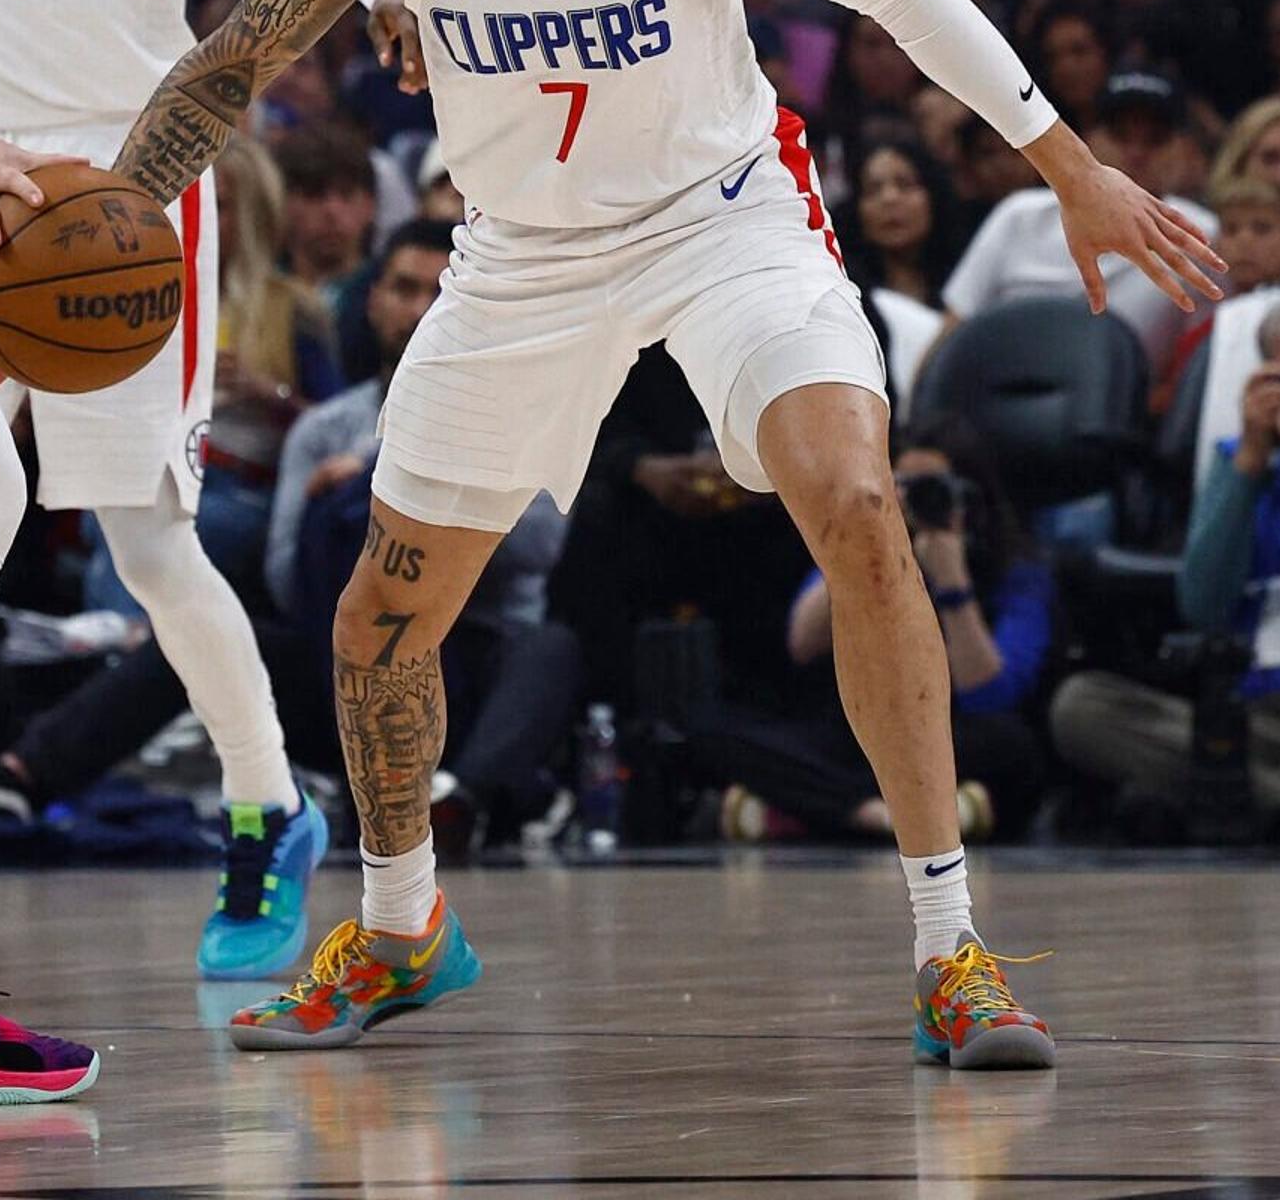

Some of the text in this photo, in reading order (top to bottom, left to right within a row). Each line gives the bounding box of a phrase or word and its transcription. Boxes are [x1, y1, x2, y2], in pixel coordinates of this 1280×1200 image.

[538, 82, 589, 164] 7
[57, 277, 181, 329] Wilson
[384, 538, 426, 584] US
[372, 612, 416, 668] 7
